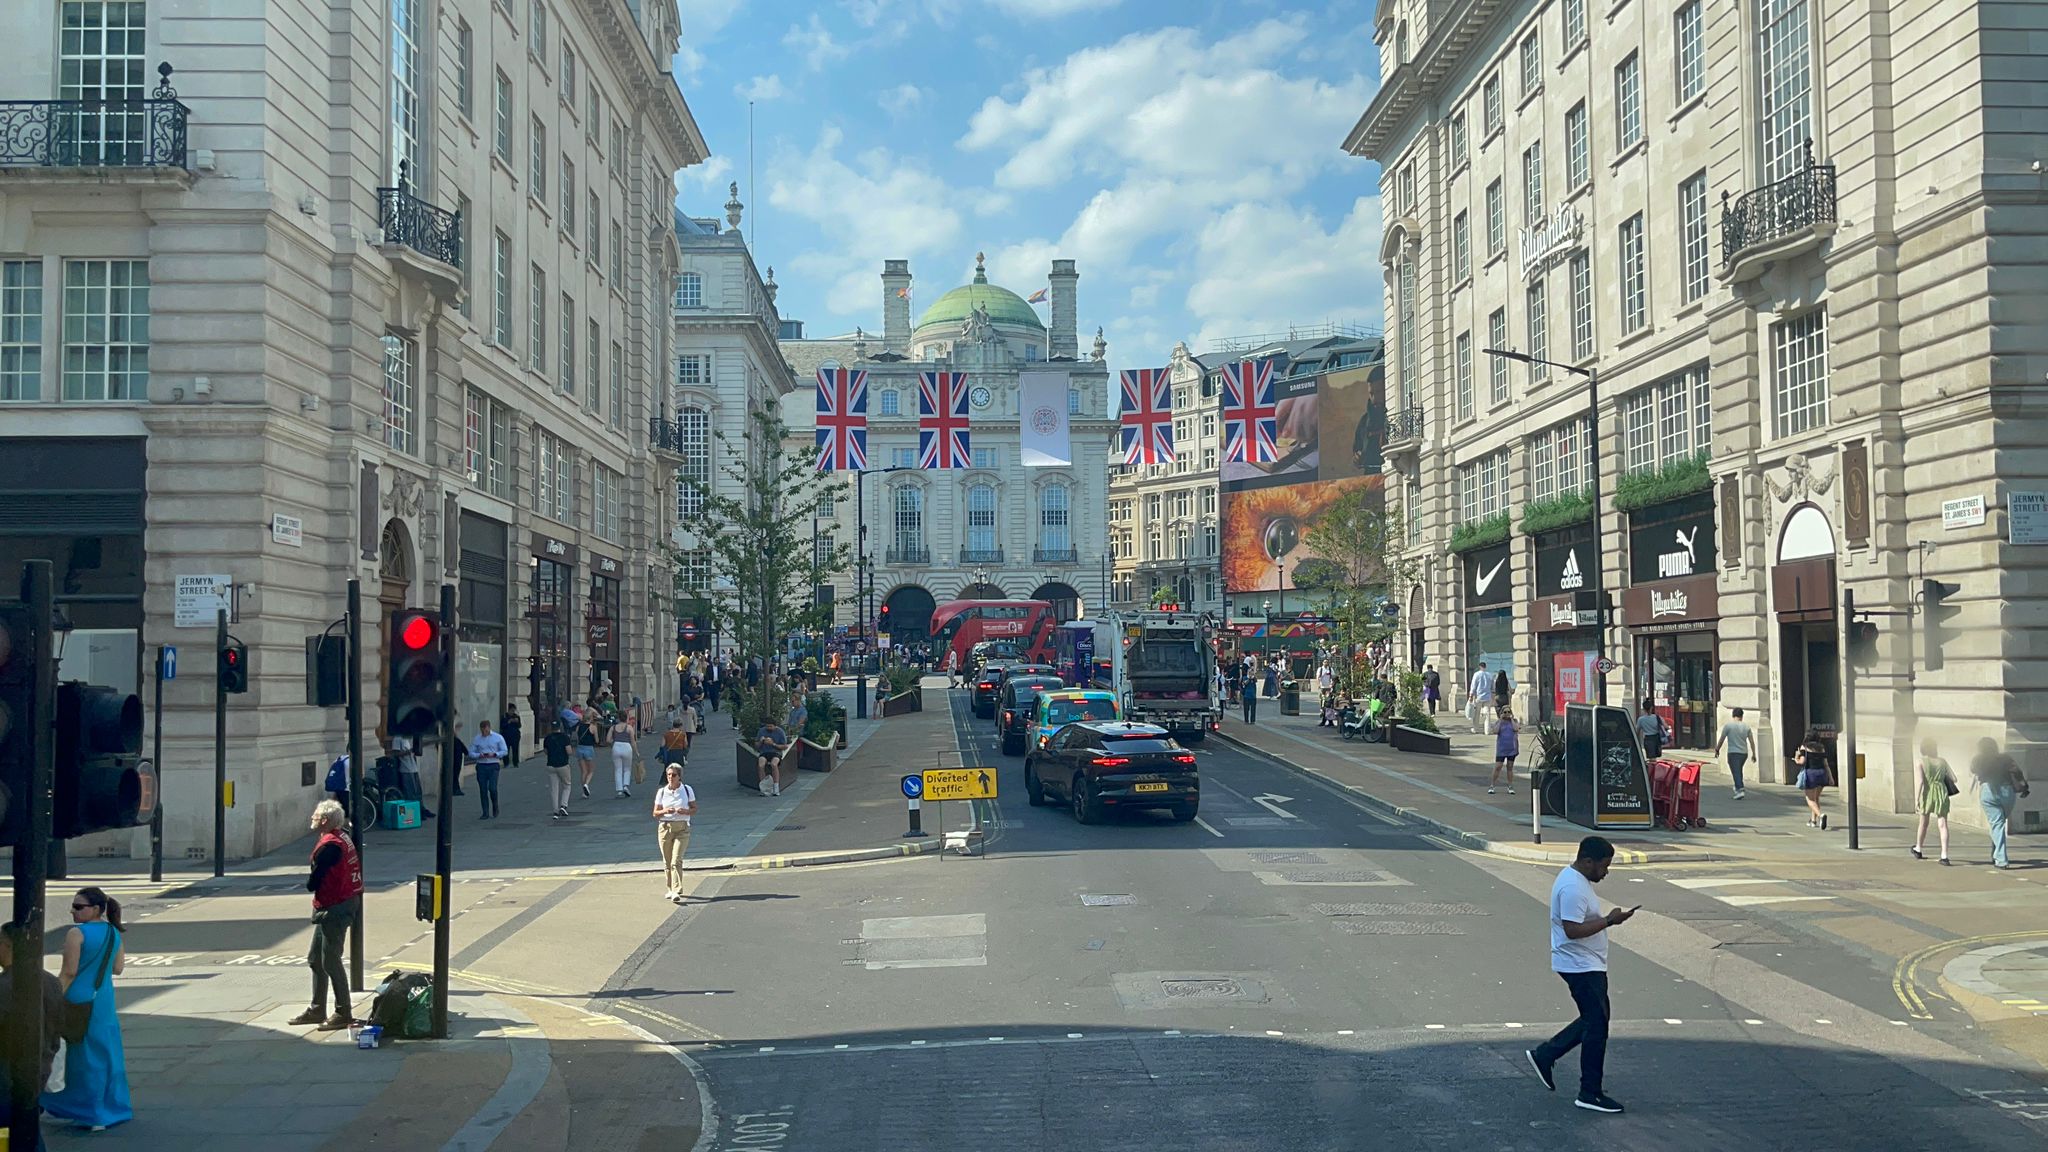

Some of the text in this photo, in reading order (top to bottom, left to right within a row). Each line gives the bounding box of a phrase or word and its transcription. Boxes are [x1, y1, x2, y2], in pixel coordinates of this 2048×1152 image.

[1290, 381, 1315, 391] SAMSUNG
[1944, 499, 1979, 511] REGENT STREET
[2013, 504, 2040, 512] STREET
[1659, 551, 1690, 577] PUMA
[180, 577, 213, 585] JERMYN
[1561, 573, 1583, 589] adidas
[179, 586, 208, 594] STREET
[1651, 589, 1687, 619] Lillywhites
[1563, 672, 1577, 688] SALE
[926, 773, 969, 784] Diverted
[932, 784, 963, 794] traffic
